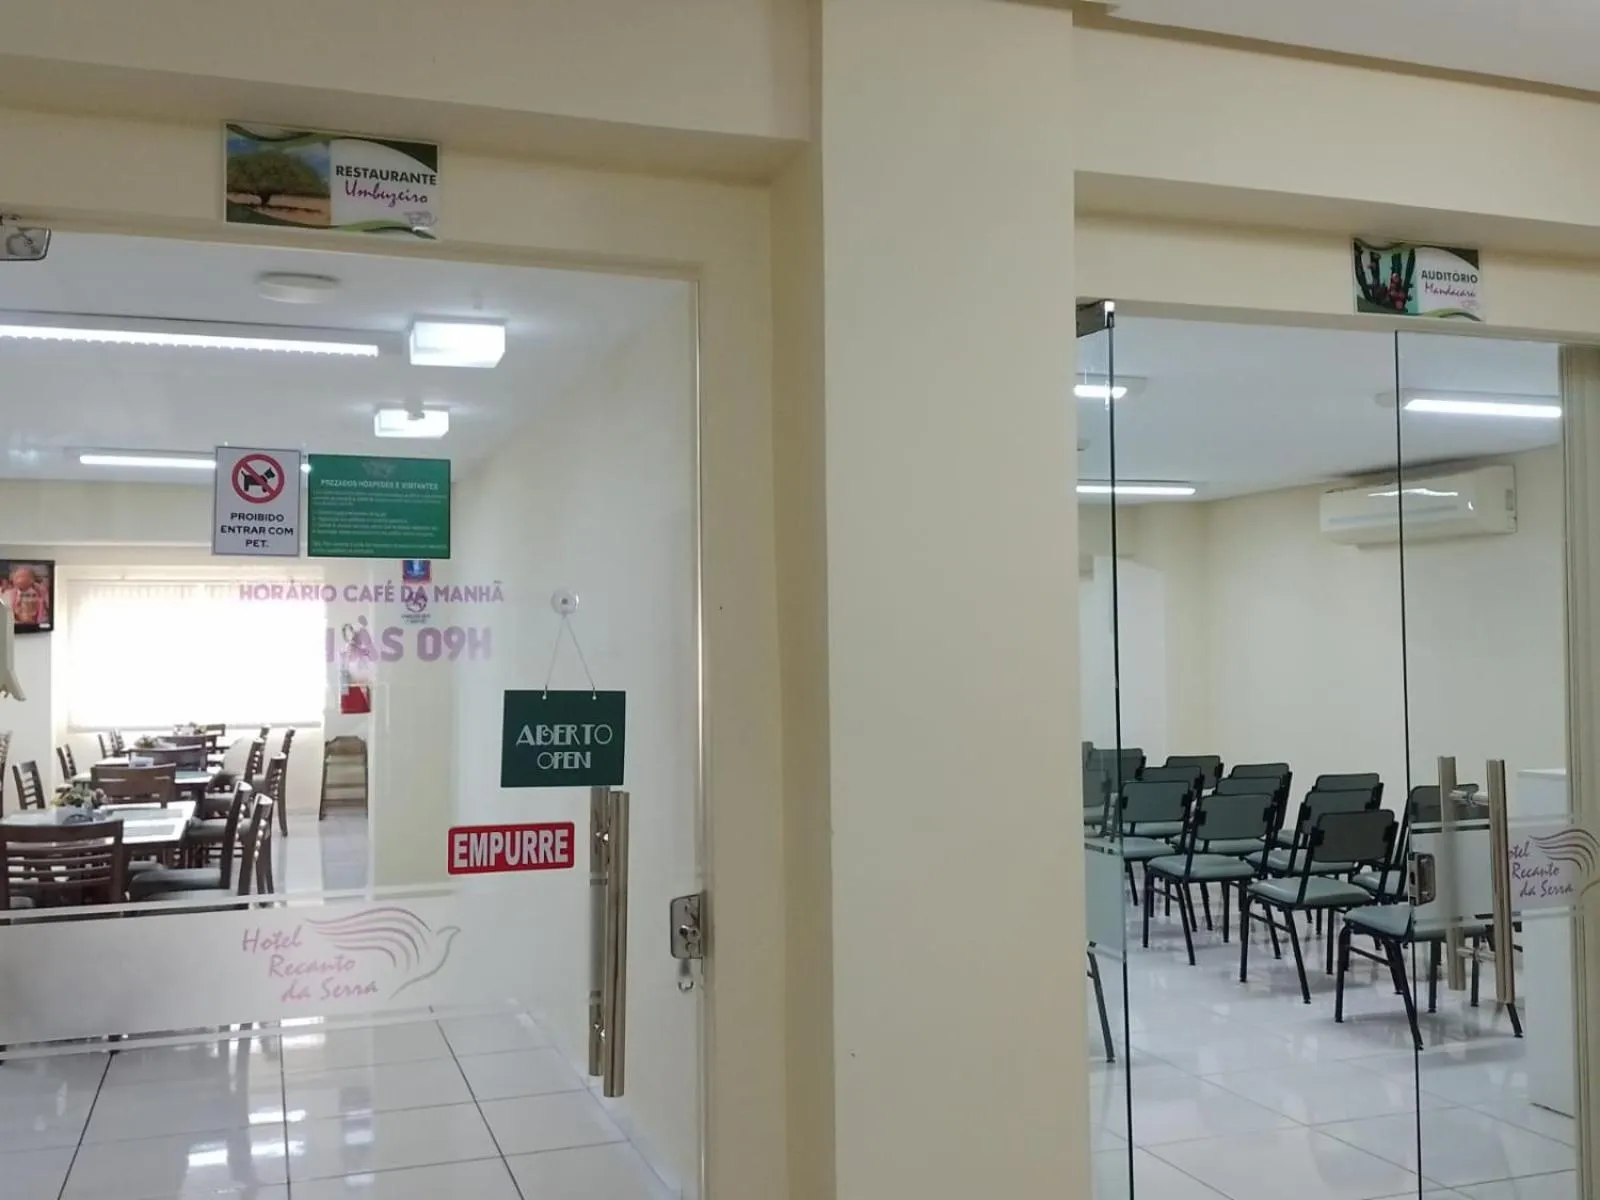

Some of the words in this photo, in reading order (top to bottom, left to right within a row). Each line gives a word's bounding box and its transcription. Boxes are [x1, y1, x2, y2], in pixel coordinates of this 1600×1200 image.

[335, 165, 437, 185] RESTAURANTE
[344, 179, 428, 207] Umbuzeiro
[1422, 269, 1478, 283] AUDITÓRIO
[230, 512, 284, 523] PROIBIDO
[220, 525, 265, 535] ENTRAR
[268, 527, 294, 536] COM
[245, 539, 269, 549] PET.
[239, 578, 337, 602] HORÁRIO
[343, 580, 394, 603] CAFÉ
[400, 584, 428, 603] DA
[434, 580, 504, 603] MANHÃ
[416, 626, 493, 662] 09H
[515, 724, 613, 746] ABERTO
[536, 751, 591, 770] OPEN
[453, 829, 569, 868] EMPURRE
[1511, 861, 1560, 880] Recanto
[1540, 880, 1574, 897] Serra
[241, 924, 303, 952] Hotel
[268, 954, 356, 978] Recanto
[281, 978, 310, 1003] da
[320, 976, 378, 1001] Serra
